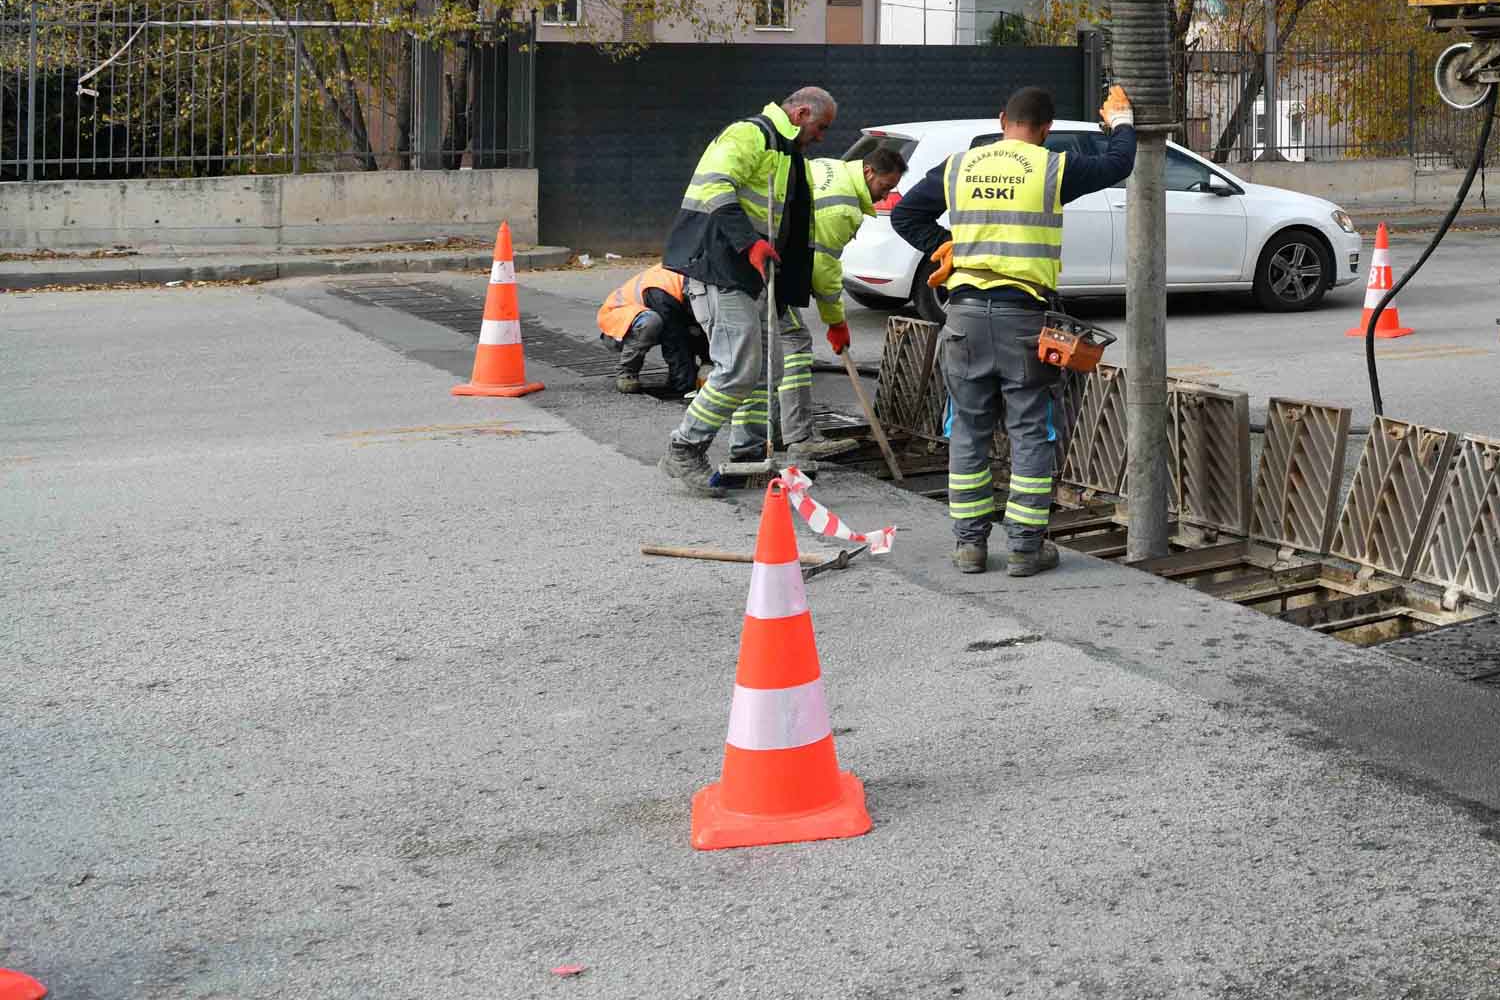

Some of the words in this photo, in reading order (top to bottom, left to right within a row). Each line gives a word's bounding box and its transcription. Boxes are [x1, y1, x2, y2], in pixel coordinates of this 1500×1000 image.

[964, 151, 992, 173] ANKARA
[965, 174, 1025, 185] BELEDİYESİ
[971, 185, 1016, 201] ASKİ
